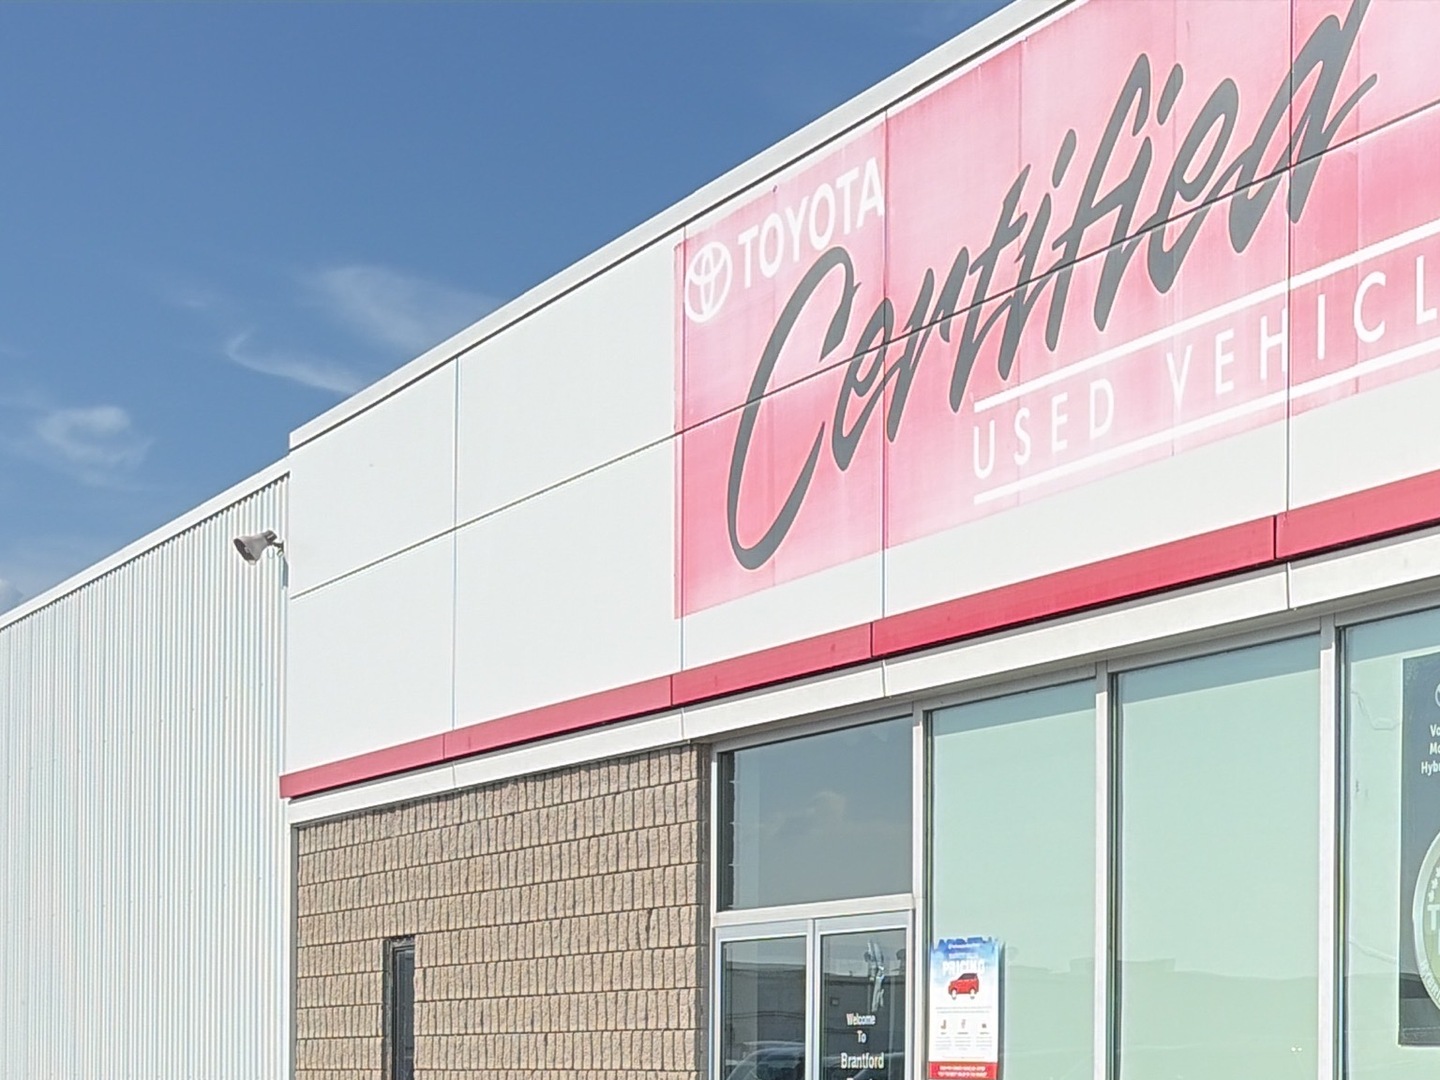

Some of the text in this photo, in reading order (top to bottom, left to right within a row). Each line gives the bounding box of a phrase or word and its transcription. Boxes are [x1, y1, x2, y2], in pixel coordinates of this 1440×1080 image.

[738, 157, 886, 289] TOYOTA
[726, 0, 1377, 570] Certified
[973, 378, 1117, 482] USED
[846, 1013, 876, 1025] Welcome
[857, 1030, 867, 1043] To
[841, 1052, 885, 1069] Brantford
